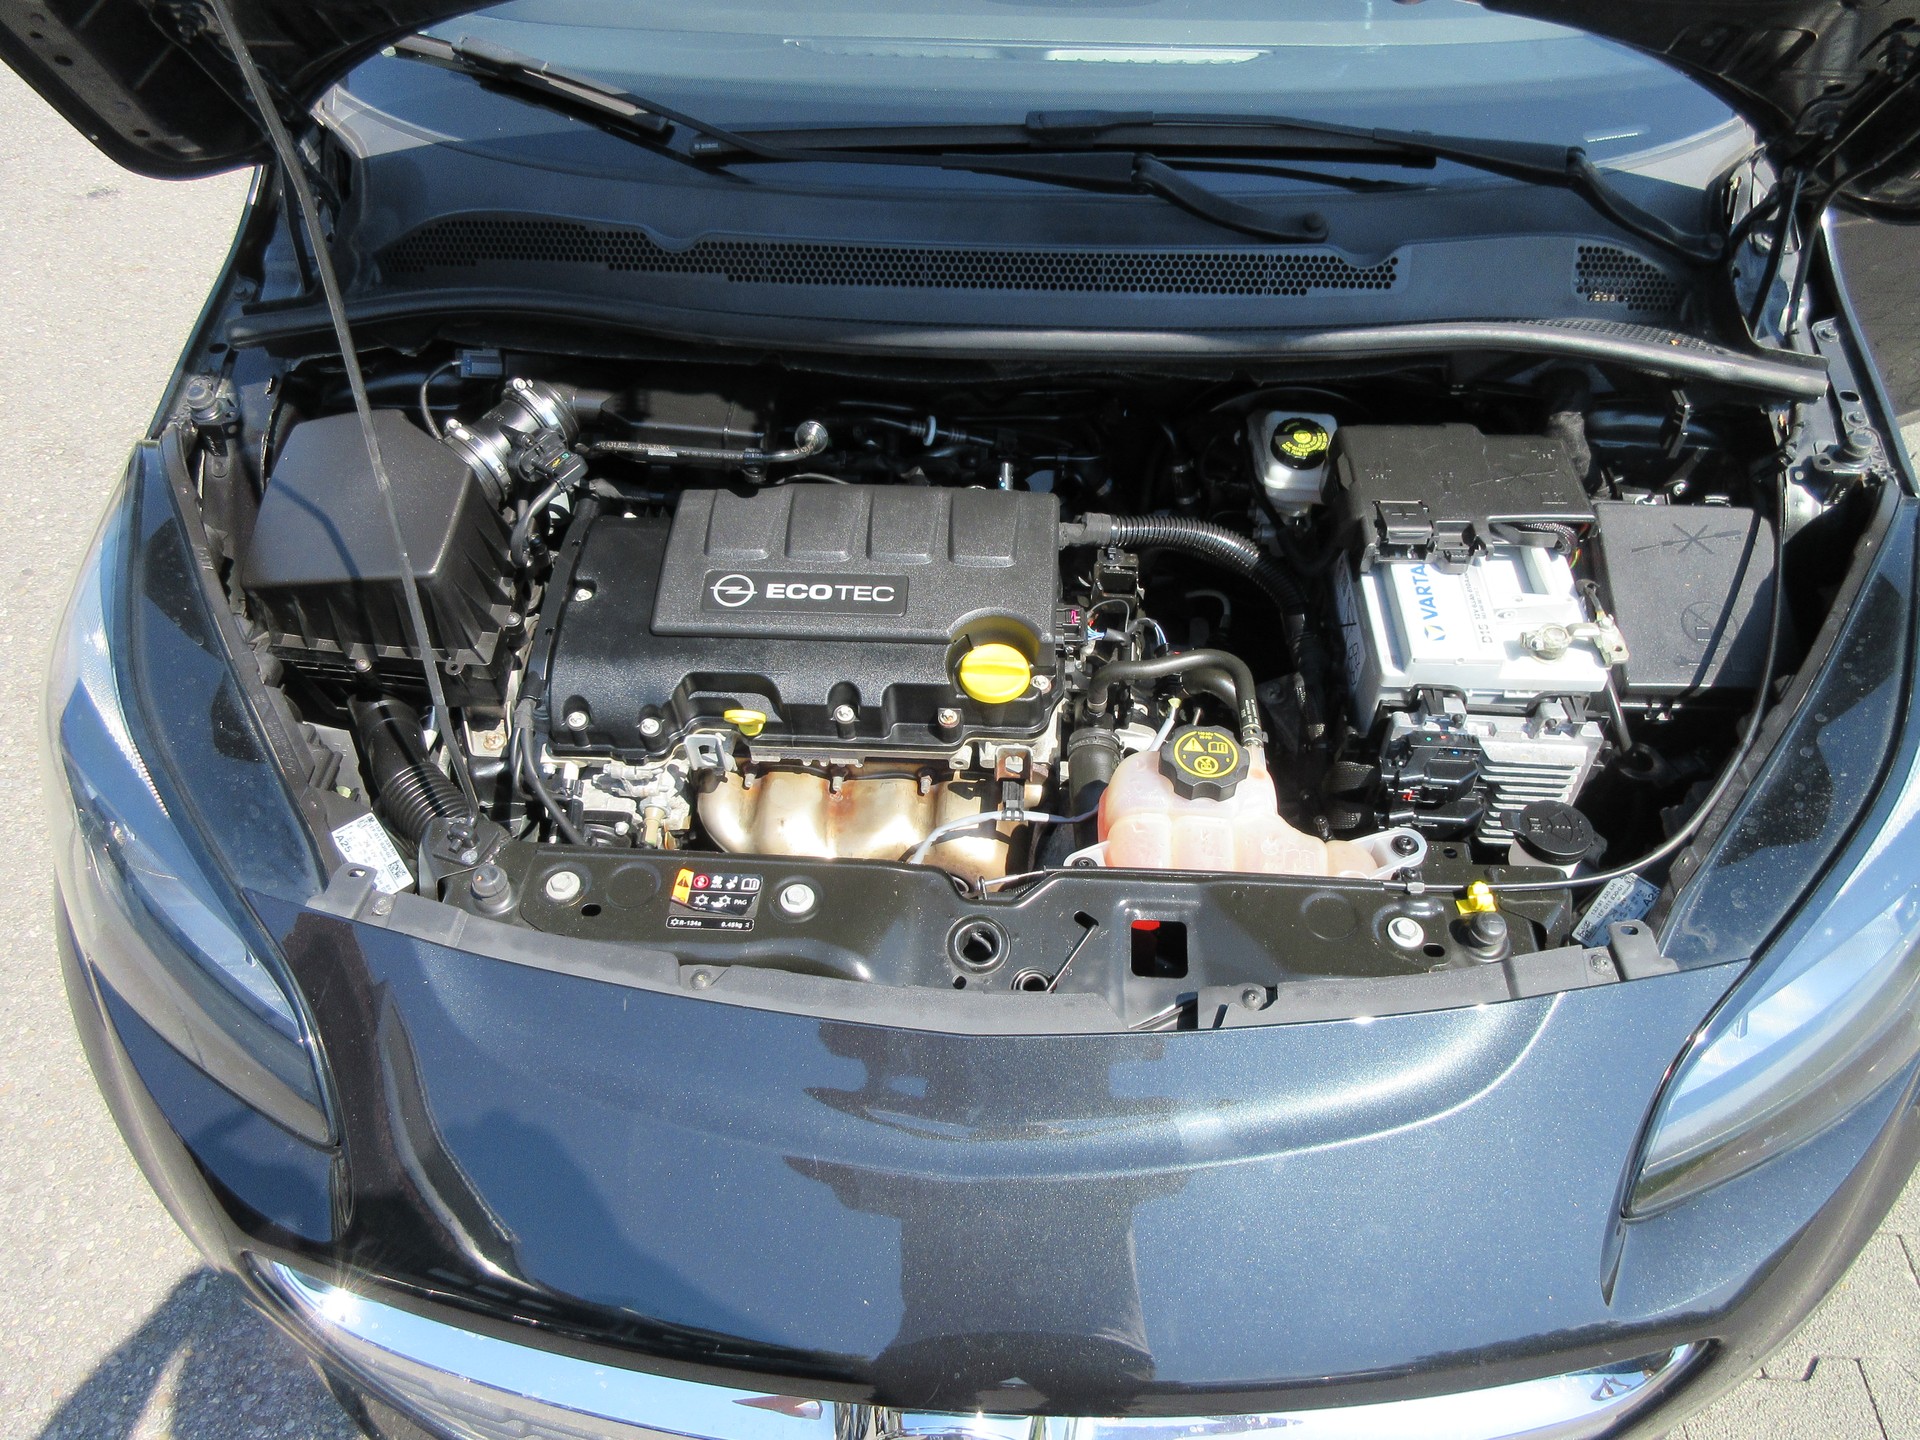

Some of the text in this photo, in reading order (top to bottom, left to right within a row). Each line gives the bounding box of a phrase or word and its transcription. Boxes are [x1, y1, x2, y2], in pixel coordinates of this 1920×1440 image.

[765, 583, 895, 602] ECOTEC
[1410, 563, 1438, 621] VARTA
[335, 835, 353, 853] A25
[733, 898, 748, 906] PAG
[1643, 888, 1661, 907] A25
